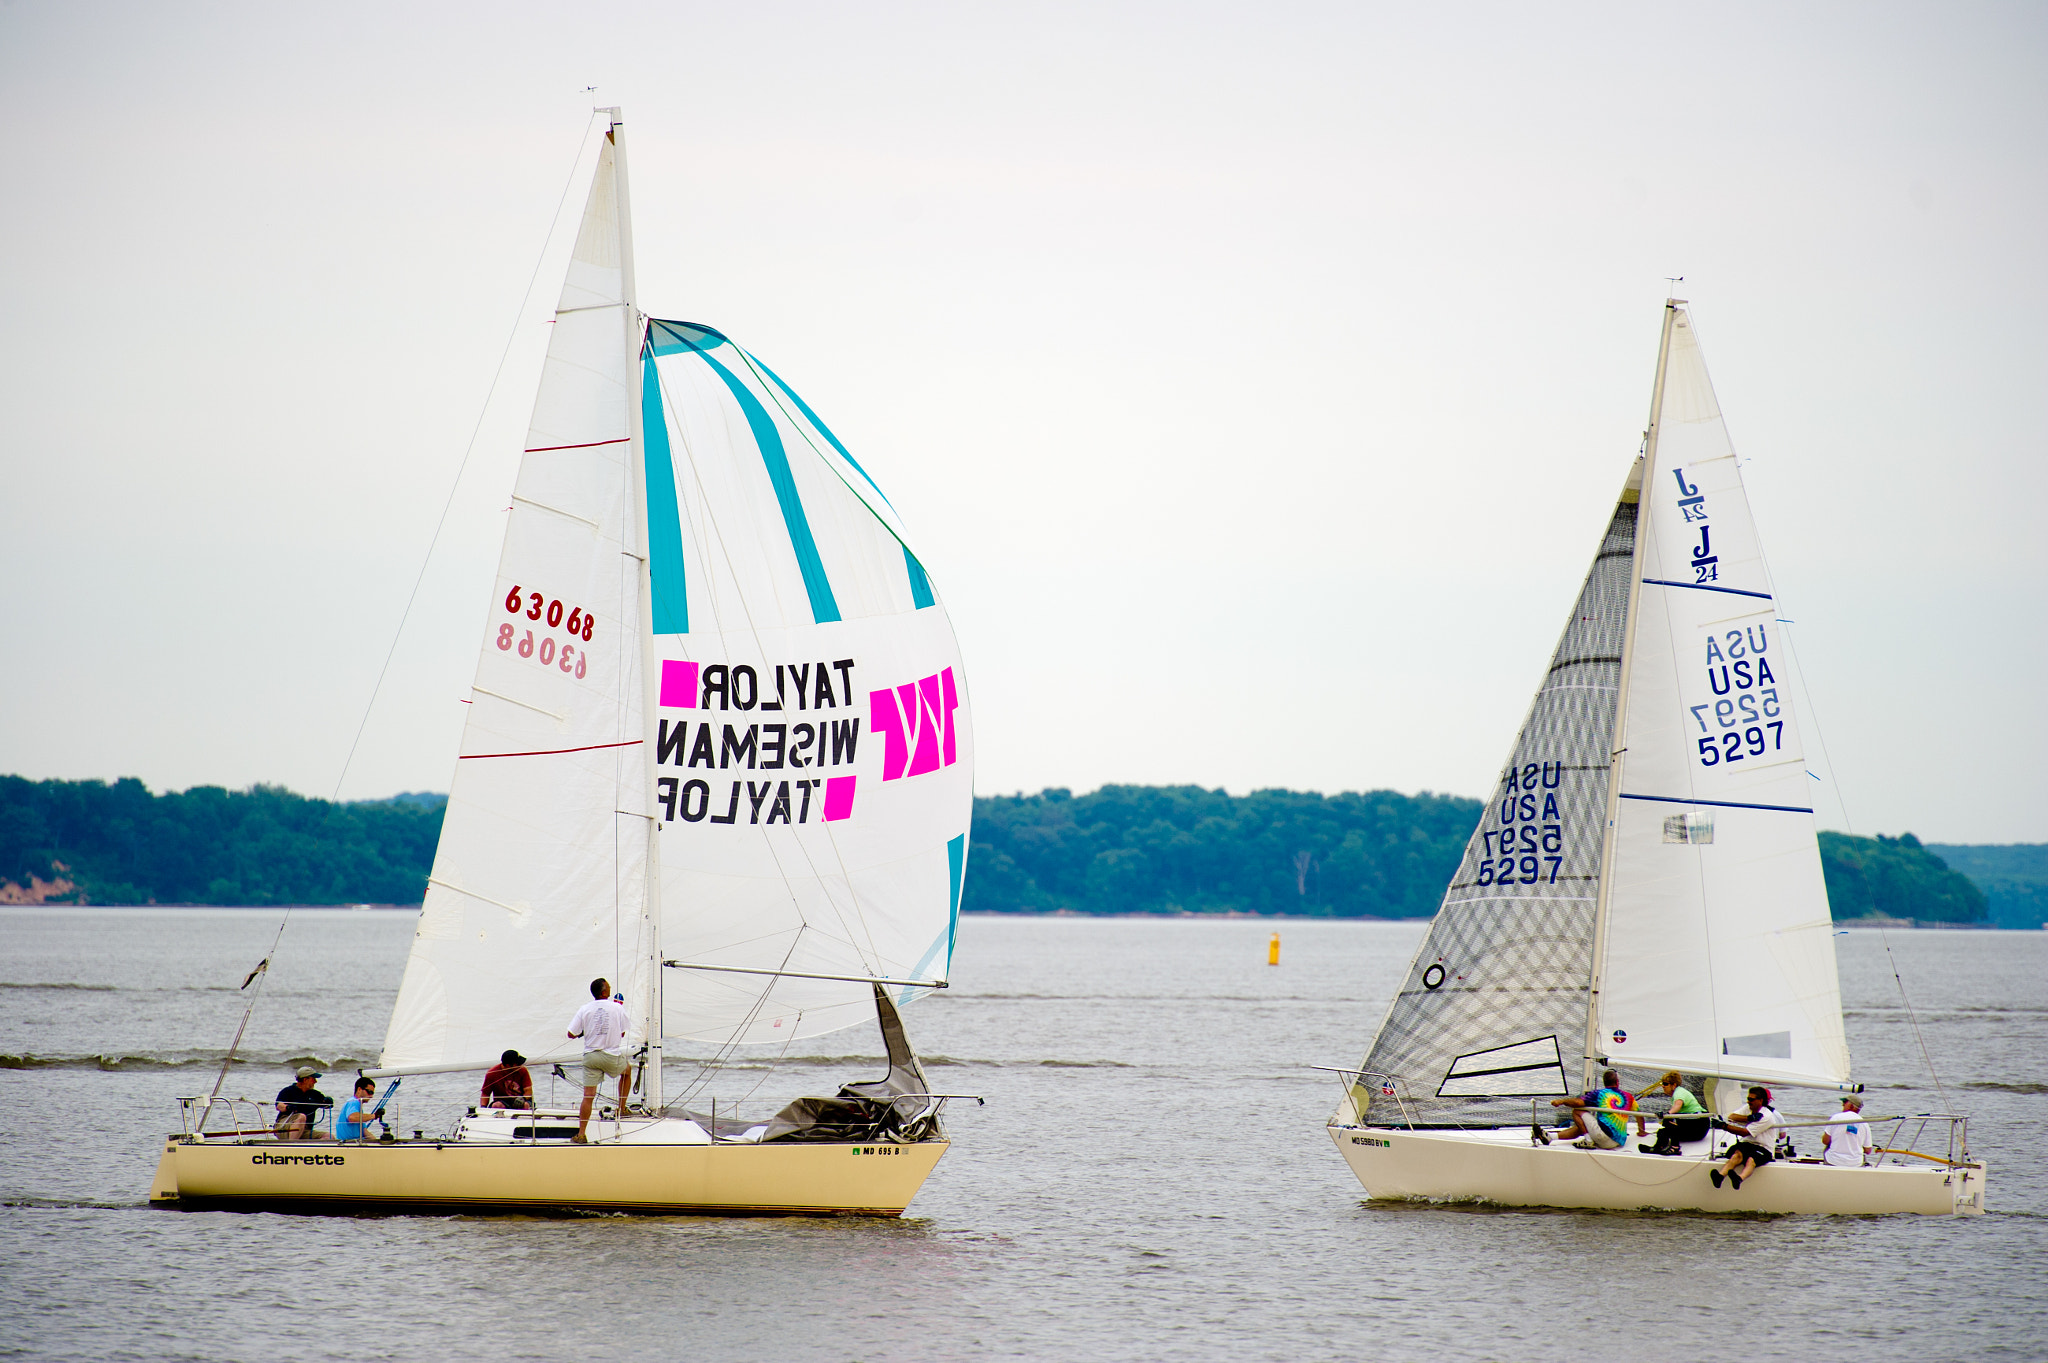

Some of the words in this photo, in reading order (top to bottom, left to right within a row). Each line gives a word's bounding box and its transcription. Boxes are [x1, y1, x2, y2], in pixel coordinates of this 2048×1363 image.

[1695, 564, 1719, 584] 24
[505, 585, 595, 642] 63068
[1708, 657, 1776, 696] USA
[1698, 720, 1785, 767] 5297
[1501, 792, 1561, 825] USA
[1477, 856, 1563, 887] 5297
[251, 1151, 345, 1166] charrette
[863, 1147, 875, 1155] MD
[878, 1147, 892, 1155] 695
